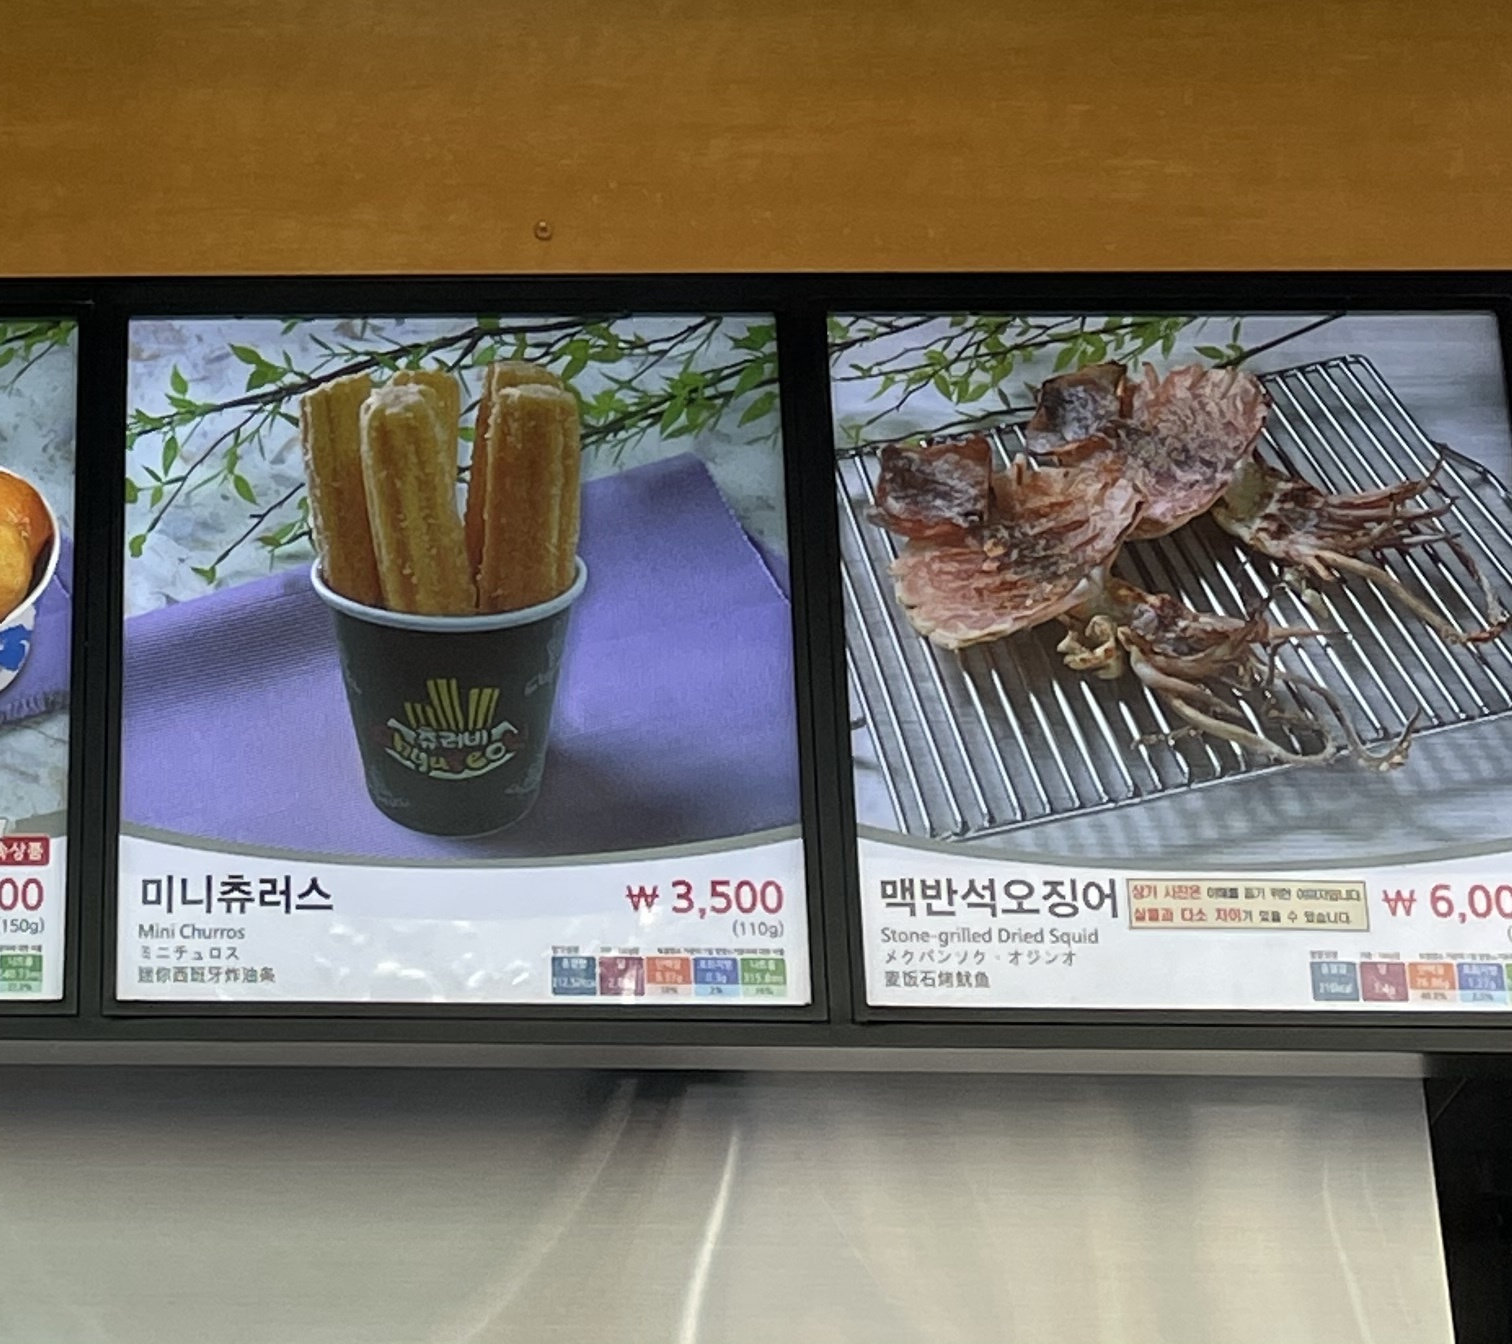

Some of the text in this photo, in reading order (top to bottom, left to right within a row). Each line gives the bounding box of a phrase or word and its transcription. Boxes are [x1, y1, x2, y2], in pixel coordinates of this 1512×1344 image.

[141, 874, 335, 914] 미니츄러스
[671, 879, 784, 920] 3,500
[879, 877, 1119, 919] 맥반석오징어
[138, 923, 246, 940] Mini Churros
[731, 918, 785, 939] (110g)
[880, 927, 1100, 948] Stone-grilled Dried Squid
[141, 944, 241, 962] ミニチュロス
